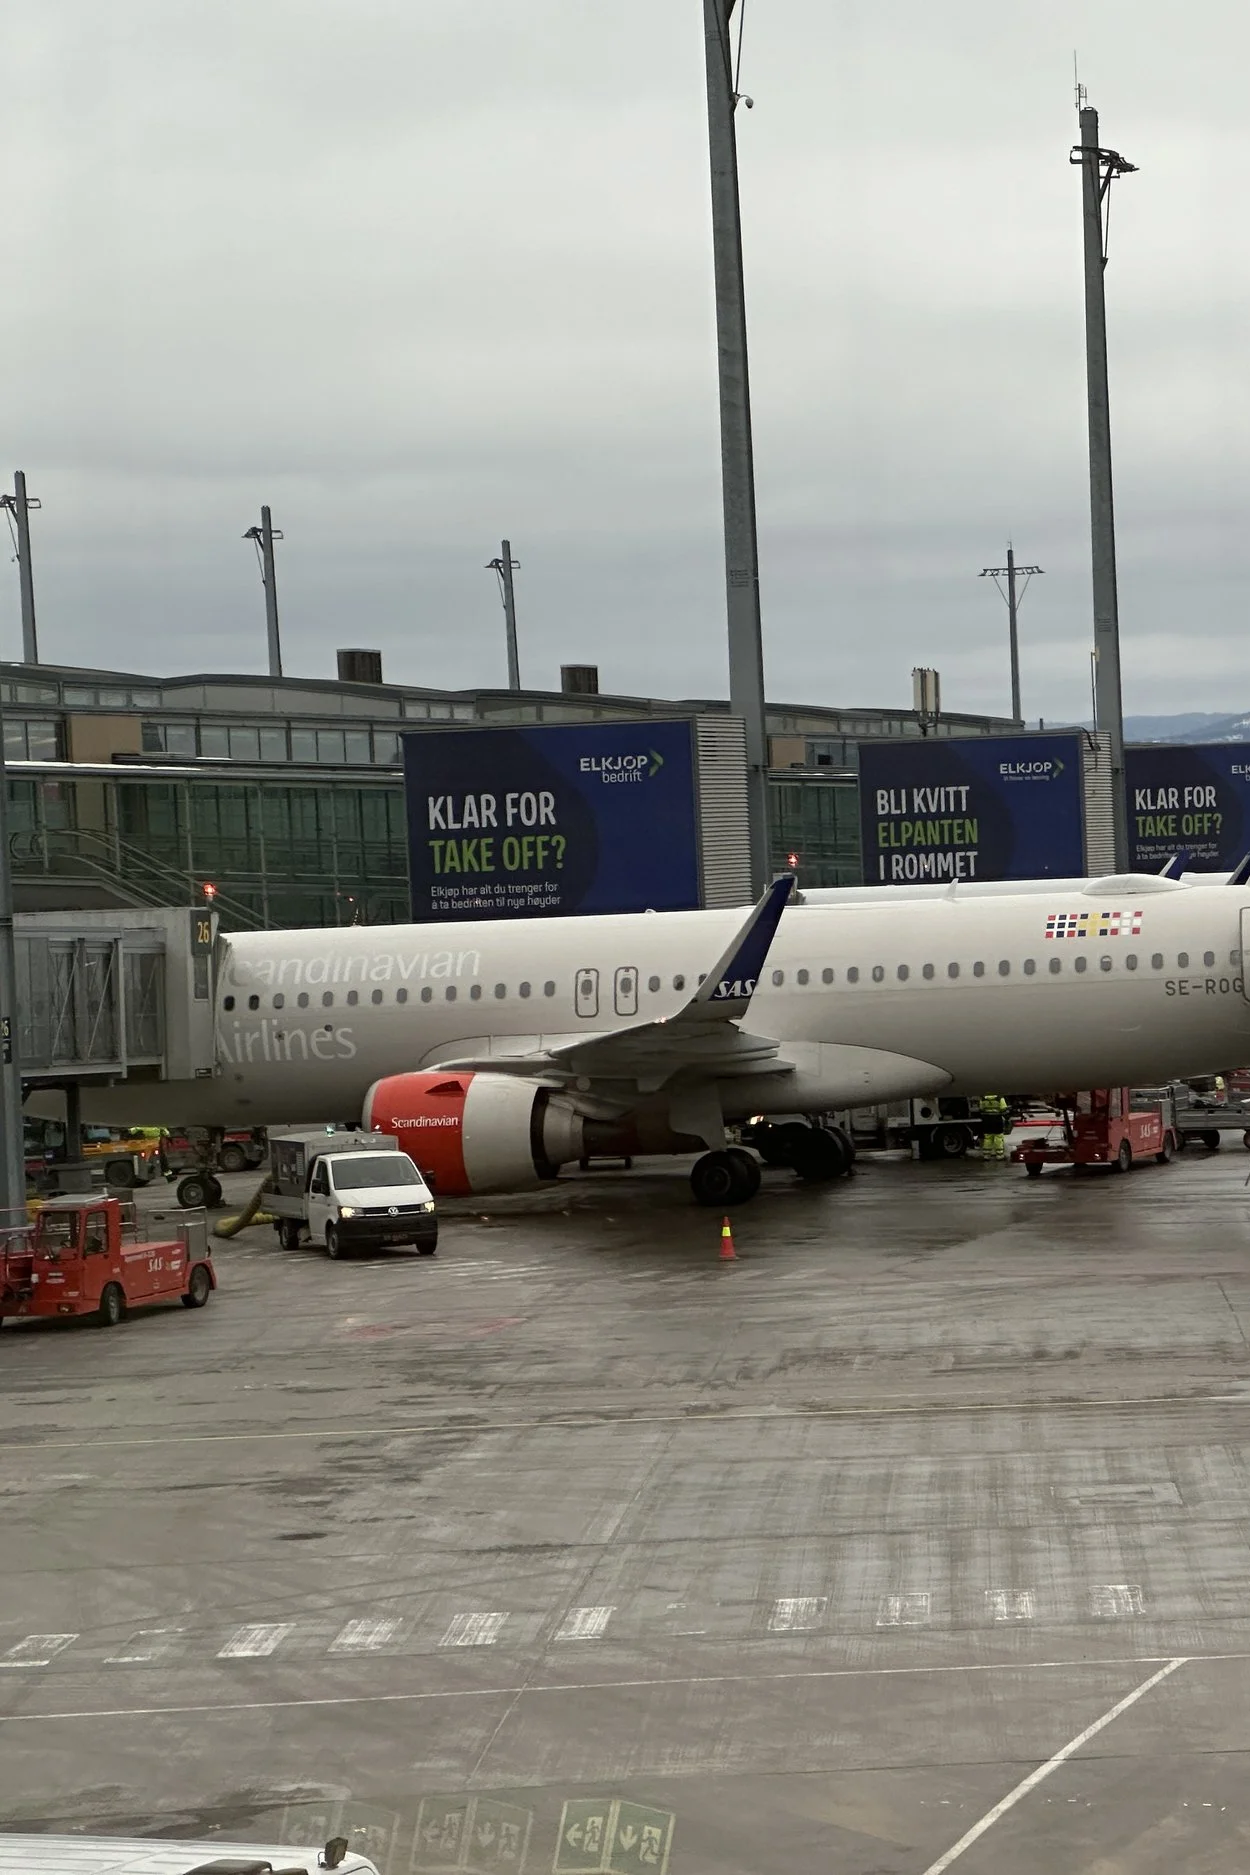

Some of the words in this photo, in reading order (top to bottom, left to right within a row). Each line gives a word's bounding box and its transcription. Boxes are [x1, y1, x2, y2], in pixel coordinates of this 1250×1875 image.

[602, 769, 643, 783] bedrift
[427, 794, 498, 830] KLAR
[505, 791, 557, 828] FOR
[876, 788, 906, 815] BLI
[913, 785, 970, 813] KVITT
[1135, 787, 1180, 811] KLAR
[1184, 785, 1217, 809] FOR
[877, 818, 979, 848] ELPANTEN
[1135, 815, 1178, 838] TAKE
[1182, 813, 1223, 836] OFF?
[429, 838, 495, 874] TAKE
[502, 835, 567, 871] OFF?
[879, 854, 885, 881] I
[891, 851, 978, 880] ROMMET
[431, 886, 459, 898] Elkjøp
[461, 885, 477, 896] har
[480, 884, 491, 895] alt
[494, 883, 506, 894] du
[508, 883, 542, 896] trenger
[544, 881, 558, 892] for
[439, 900, 449, 909] ta
[451, 898, 494, 909] bedriften
[496, 897, 505, 907] til
[507, 898, 525, 909] nye
[527, 895, 561, 908] høyder
[197, 921, 209, 943] 26
[228, 950, 482, 987] candinavian
[714, 979, 756, 998] SAS
[391, 1115, 459, 1129] Scandinavian
